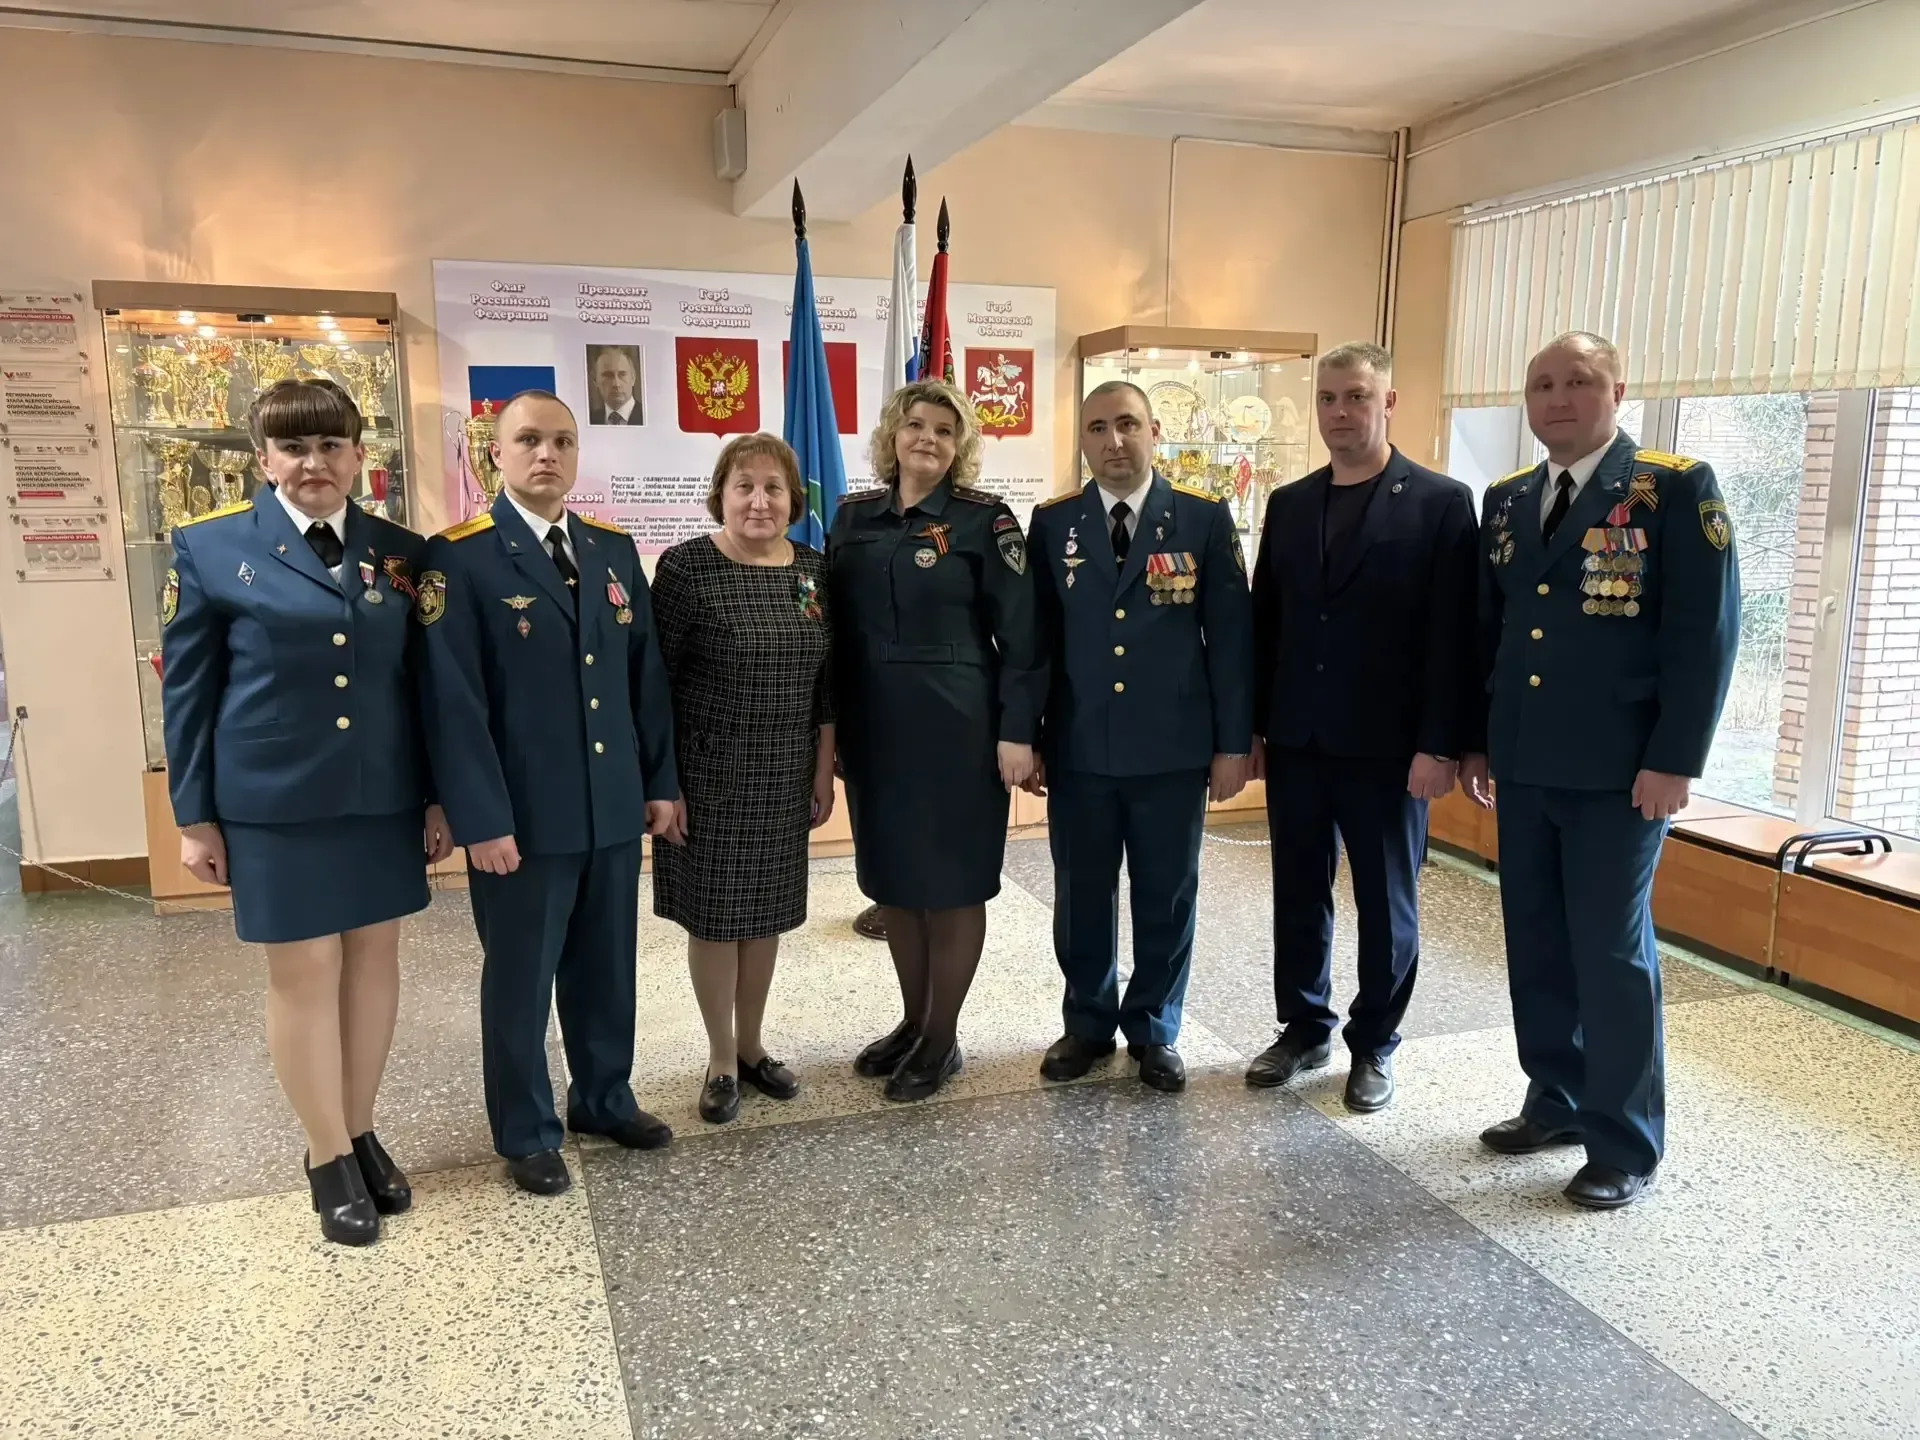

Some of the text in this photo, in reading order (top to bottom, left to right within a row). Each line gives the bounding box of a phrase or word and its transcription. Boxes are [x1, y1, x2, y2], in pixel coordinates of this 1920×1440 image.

[491, 280, 525, 292] Флаг
[578, 283, 648, 296] Президент
[470, 293, 550, 308] Российской
[699, 288, 729, 302] Герб
[815, 295, 834, 304] лаг
[576, 297, 652, 311] Российской
[679, 301, 752, 315] Российской
[986, 300, 1012, 314] Герб
[474, 307, 548, 322] Федерации
[578, 311, 650, 325] Федерации
[784, 304, 857, 319] Мовской
[682, 315, 750, 329] Федерации
[968, 313, 1033, 326] Московской
[978, 325, 1022, 338] Области
[611, 490, 642, 498] Могучая
[649, 524, 676, 532] народов
